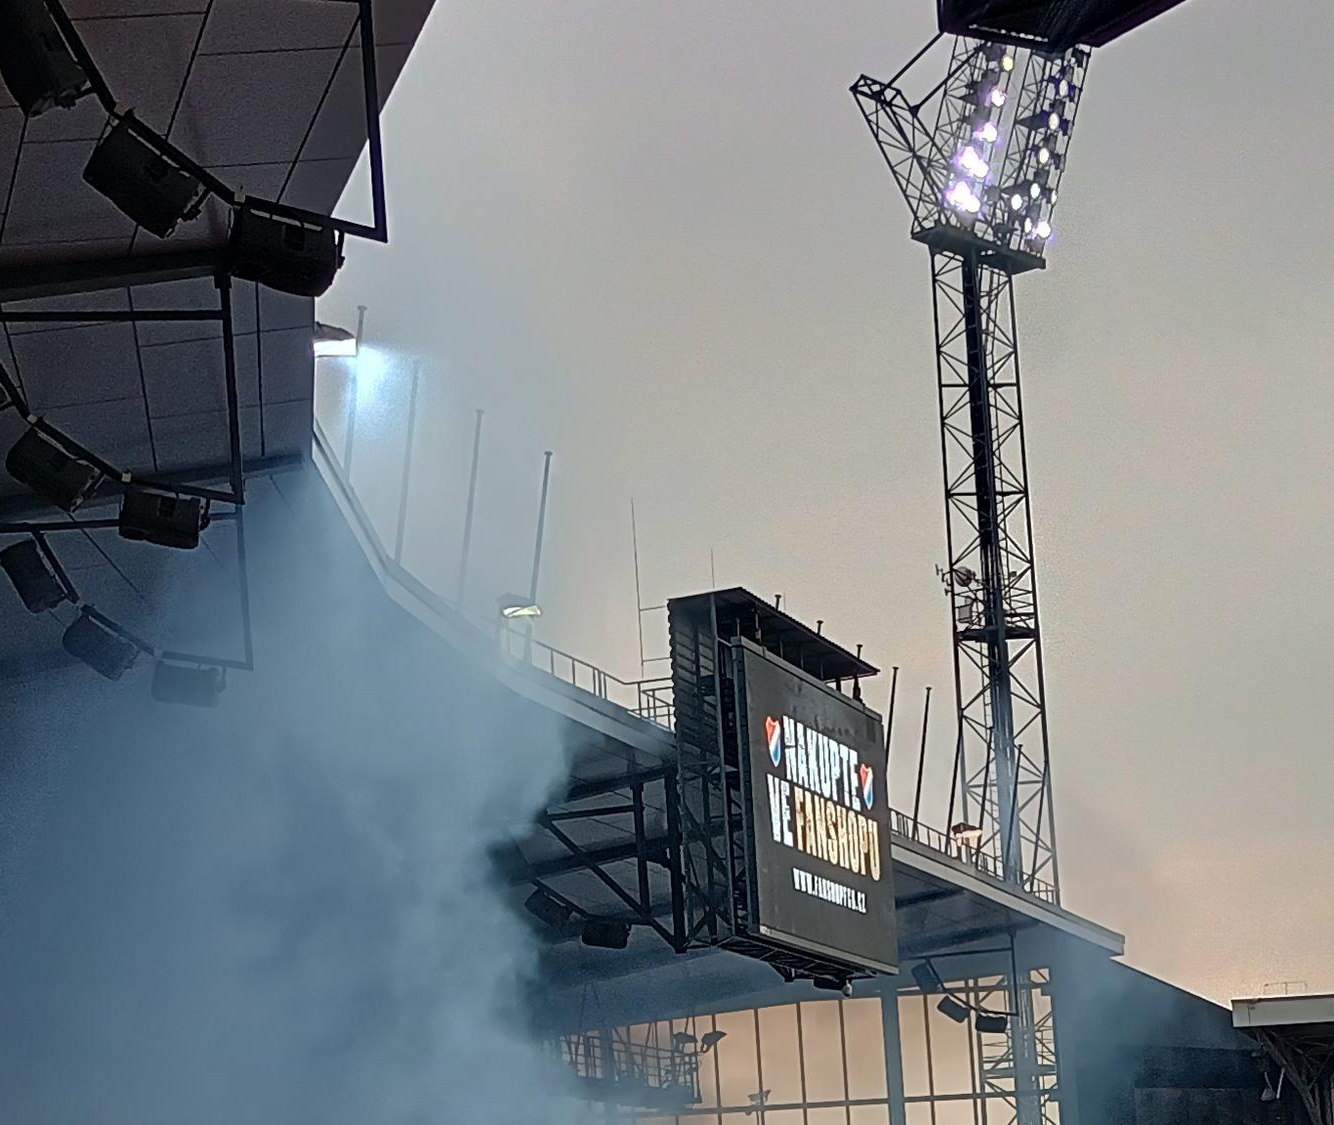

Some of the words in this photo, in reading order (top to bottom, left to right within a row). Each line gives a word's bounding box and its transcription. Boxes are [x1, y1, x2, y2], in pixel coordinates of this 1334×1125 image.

[782, 715, 861, 812] NAKUPTE
[767, 773, 793, 848] VE
[794, 785, 880, 881] FANSHOPU
